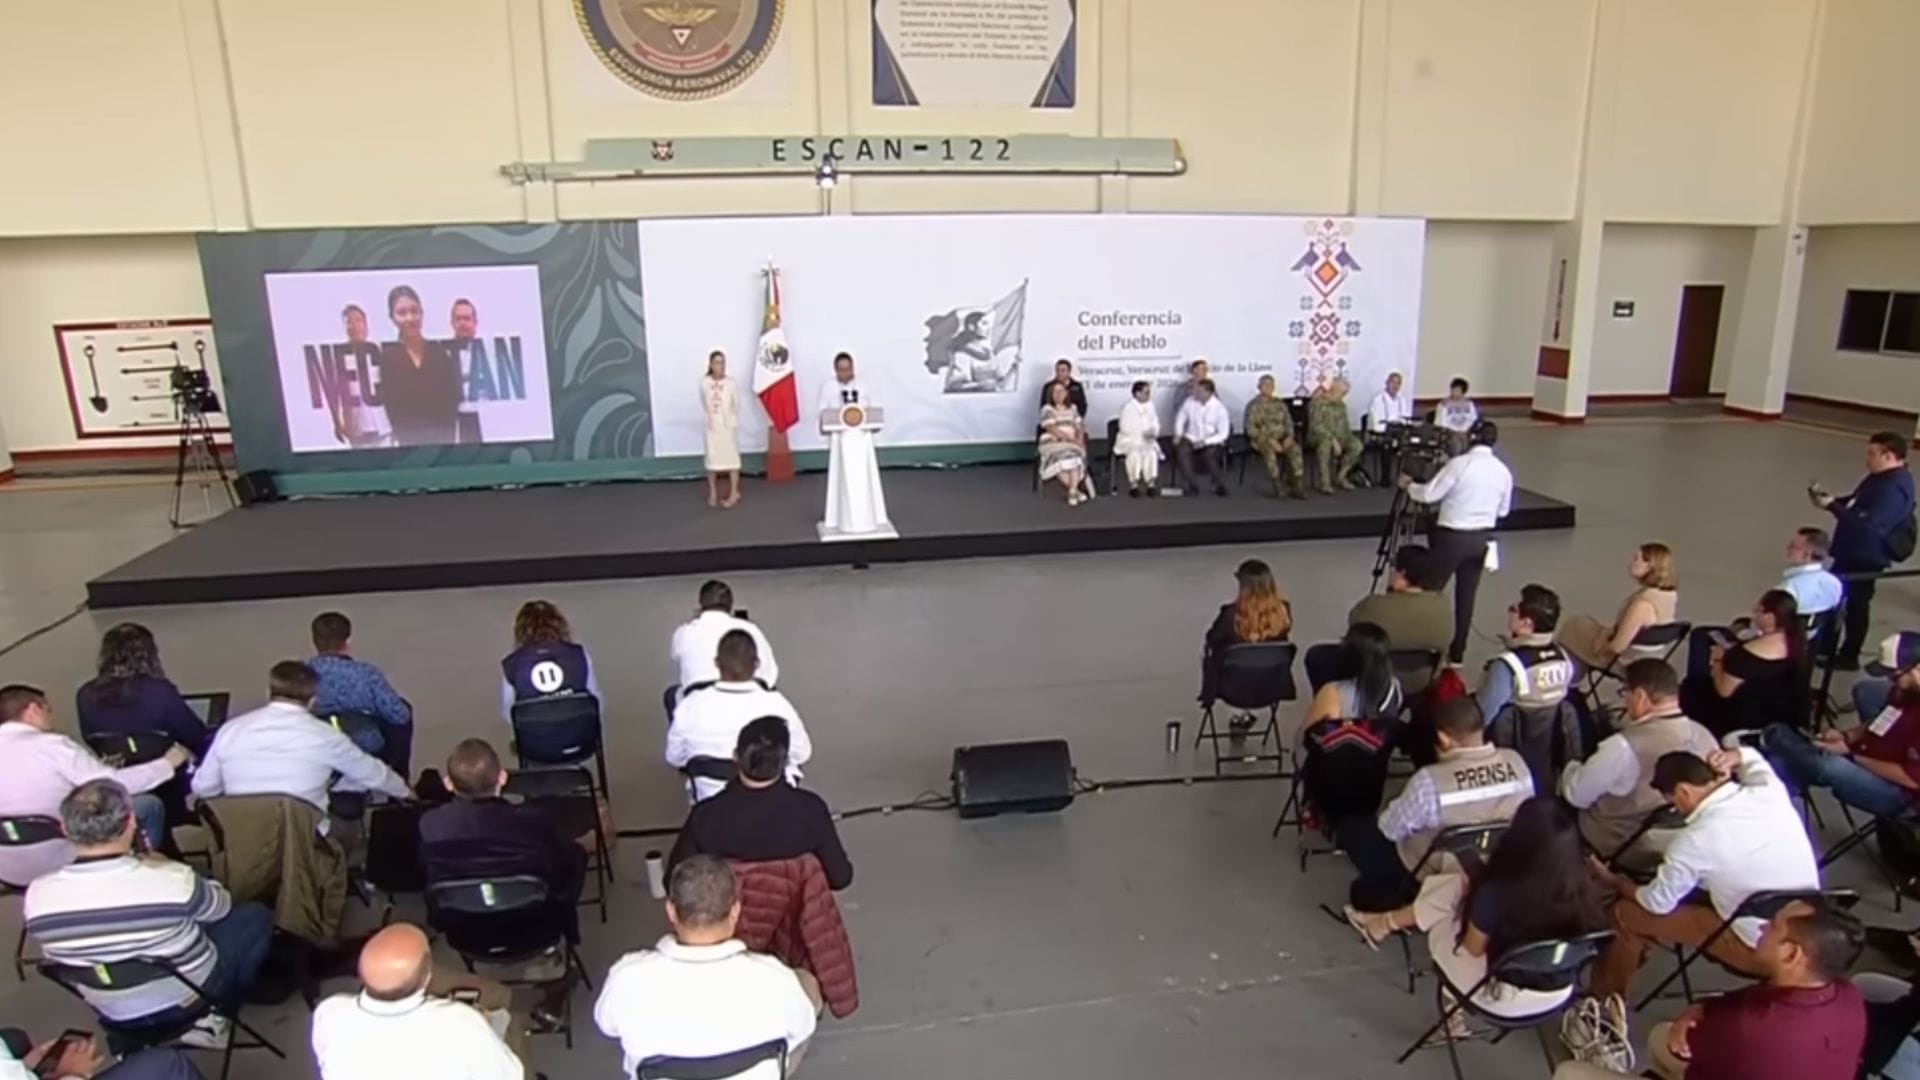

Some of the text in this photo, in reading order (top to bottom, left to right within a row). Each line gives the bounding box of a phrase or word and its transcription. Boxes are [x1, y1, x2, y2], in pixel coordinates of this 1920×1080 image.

[609, 47, 673, 87] ESCUADRÓN
[674, 65, 741, 88] AERONAVAL
[1078, 309, 1182, 327] Conferencia
[1078, 333, 1167, 351] del Pueblo
[1126, 364, 1169, 375] Veracruz
[1223, 361, 1235, 372] de
[1238, 361, 1247, 372] la
[1249, 360, 1272, 372] Llave
[1454, 761, 1518, 791] PRENSA
